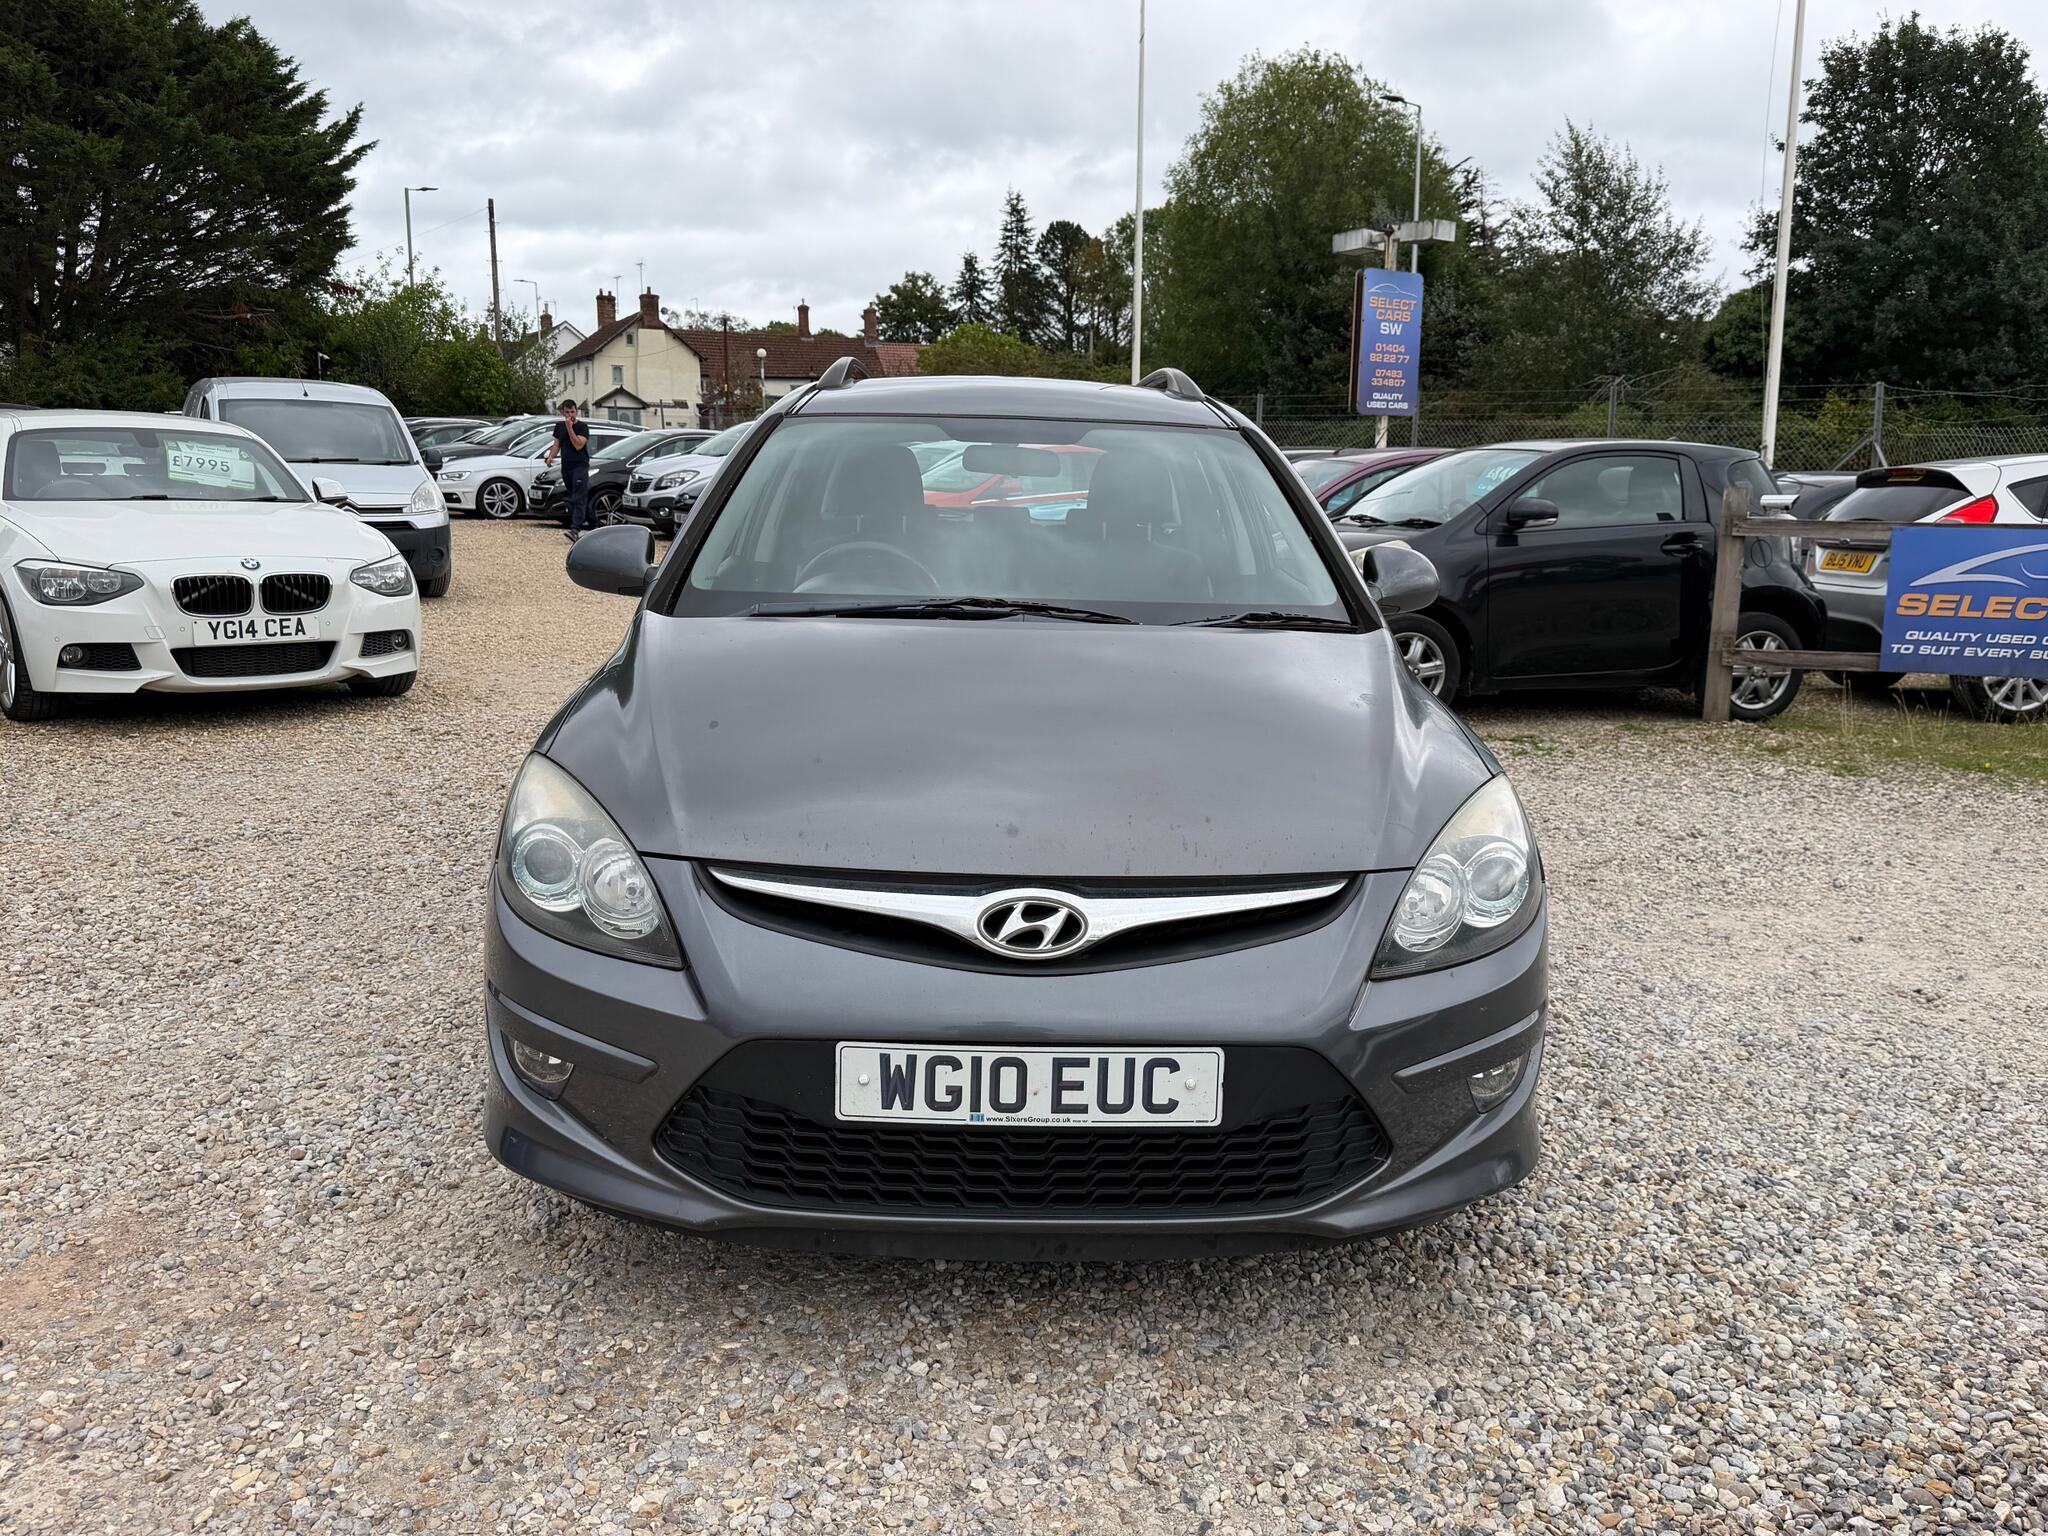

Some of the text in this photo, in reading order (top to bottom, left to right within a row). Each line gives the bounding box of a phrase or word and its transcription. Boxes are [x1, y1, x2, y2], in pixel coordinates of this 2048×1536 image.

[1369, 296, 1417, 311] SELECT
[1376, 309, 1411, 322] CARS
[1380, 322, 1403, 335] SW
[1375, 343, 1405, 353] 01404
[1372, 392, 1403, 400] QUALITY
[1388, 402, 1409, 410] CARS
[173, 455, 231, 473] £7995
[1896, 593, 2048, 620] SELEC
[207, 617, 306, 640] YG14 CEA
[1905, 630, 1982, 642] QUALITY
[1986, 633, 2037, 645] USED
[1891, 644, 1914, 654] TO
[1918, 645, 1960, 656] SUIT
[1963, 647, 2026, 659] EVERY
[879, 1053, 1181, 1114] WG10 EUC
